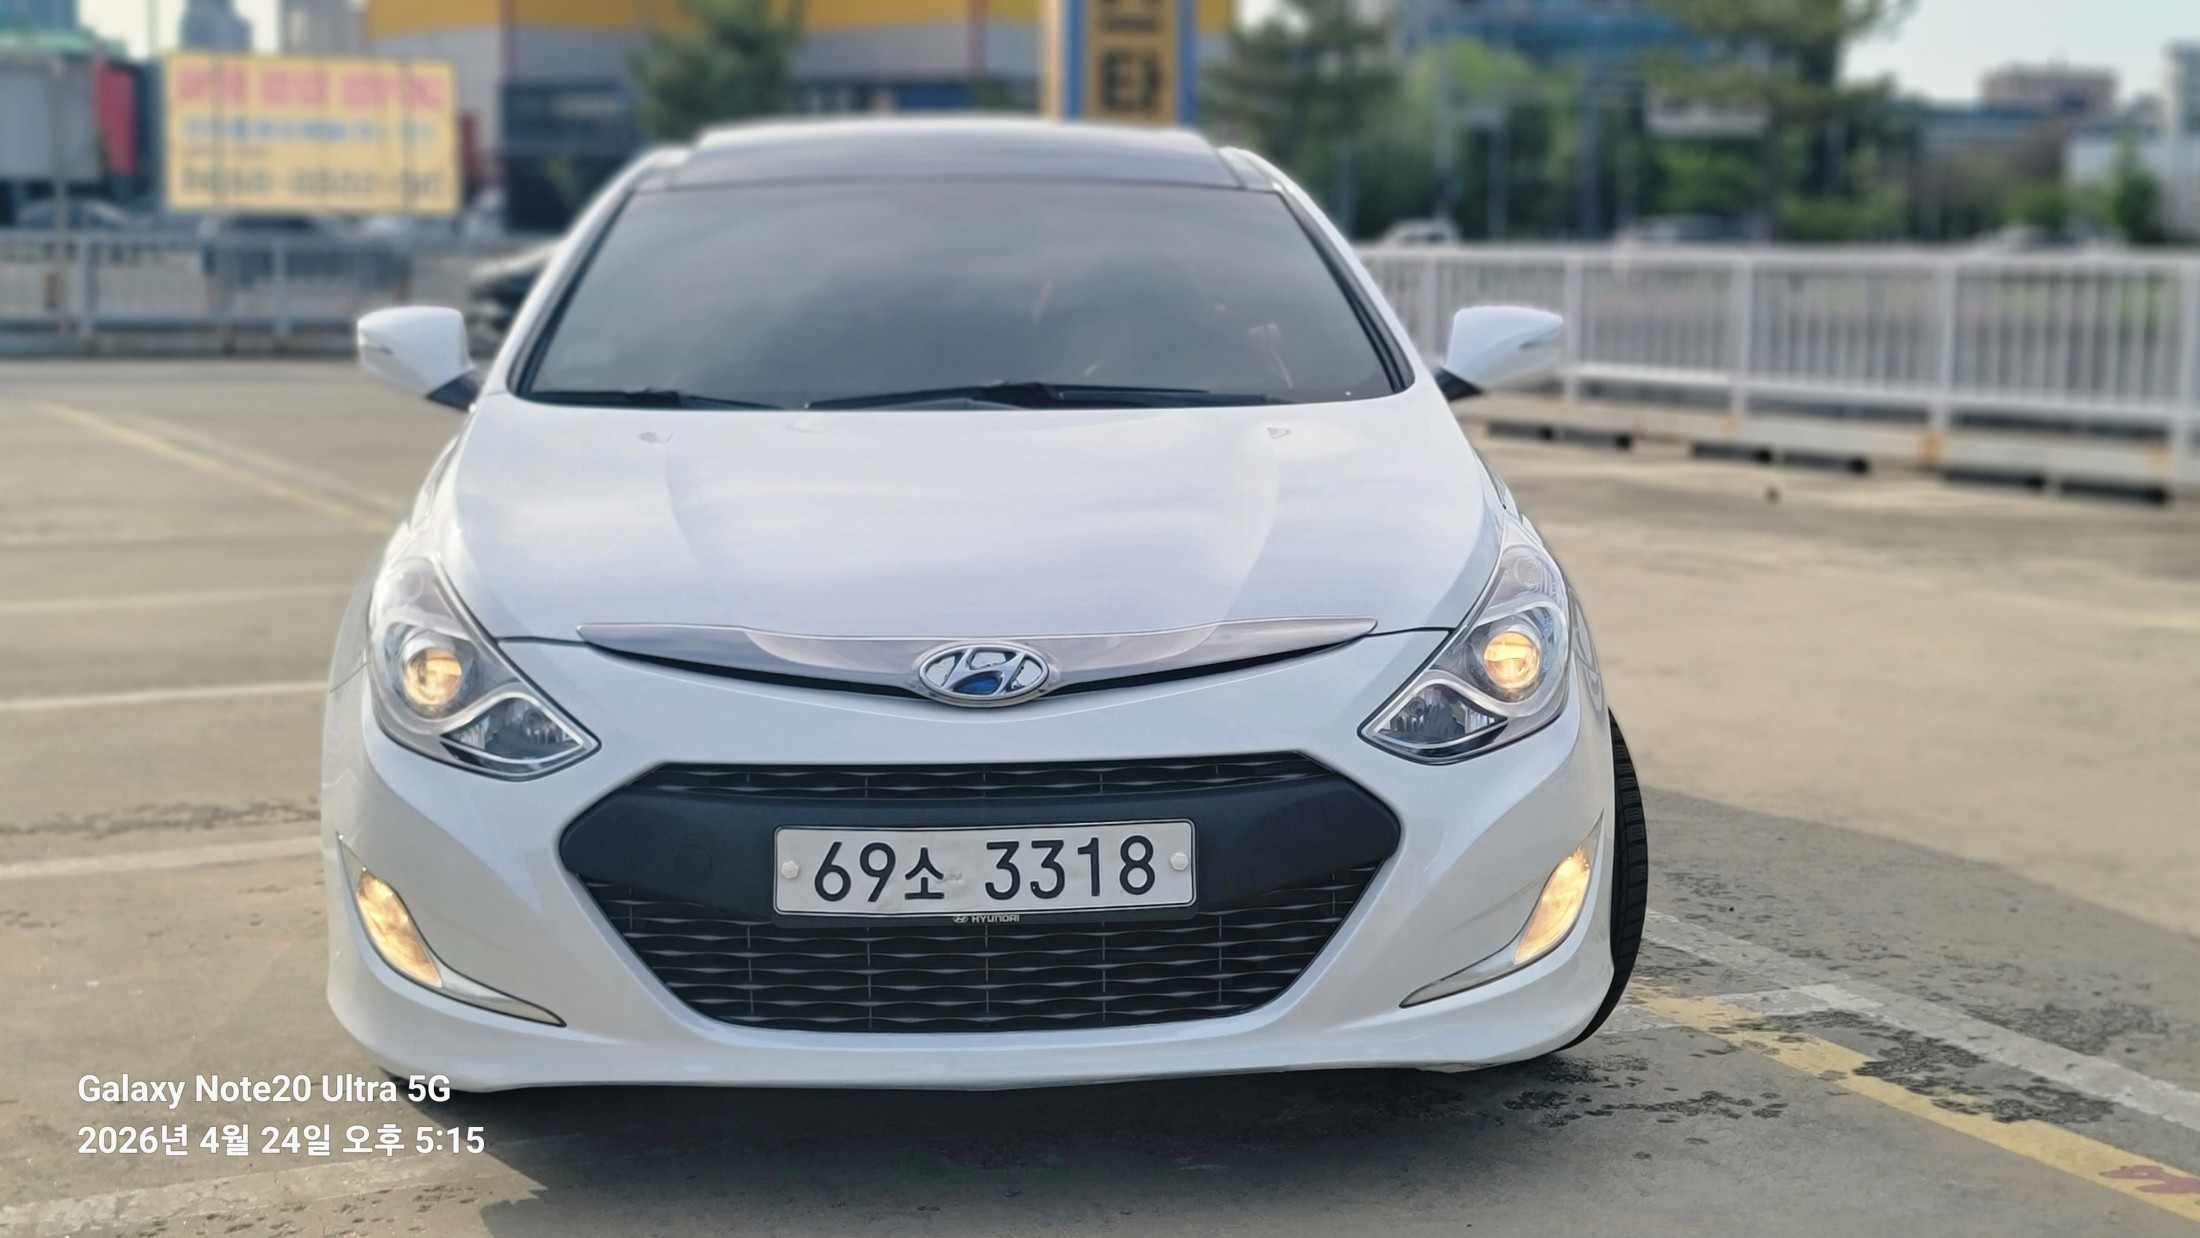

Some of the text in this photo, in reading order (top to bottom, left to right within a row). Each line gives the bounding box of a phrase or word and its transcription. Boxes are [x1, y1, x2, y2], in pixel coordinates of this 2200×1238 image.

[814, 835, 1156, 903] 69소 3318
[971, 913, 1020, 924] HYUNDAI
